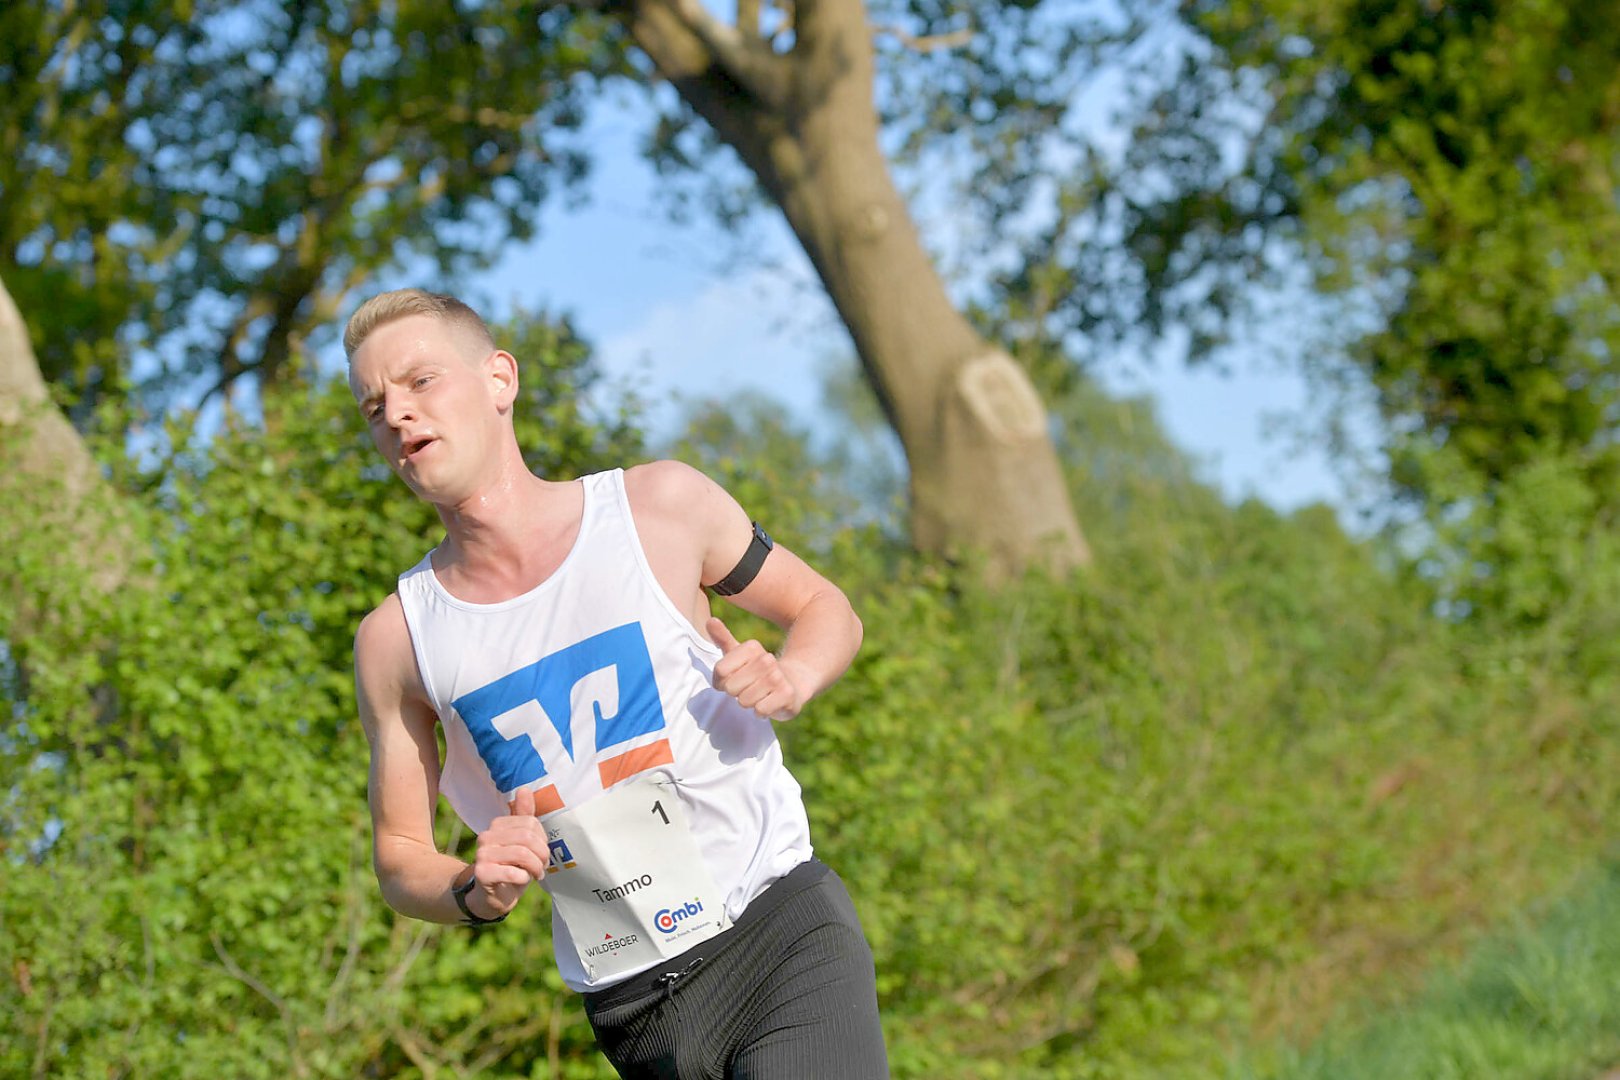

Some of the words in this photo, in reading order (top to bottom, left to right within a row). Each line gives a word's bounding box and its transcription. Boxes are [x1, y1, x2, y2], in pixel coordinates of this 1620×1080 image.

[651, 800, 671, 825] 1
[592, 874, 652, 903] Tammo
[654, 896, 704, 933] Combi
[584, 934, 639, 957] WILDEBOER
